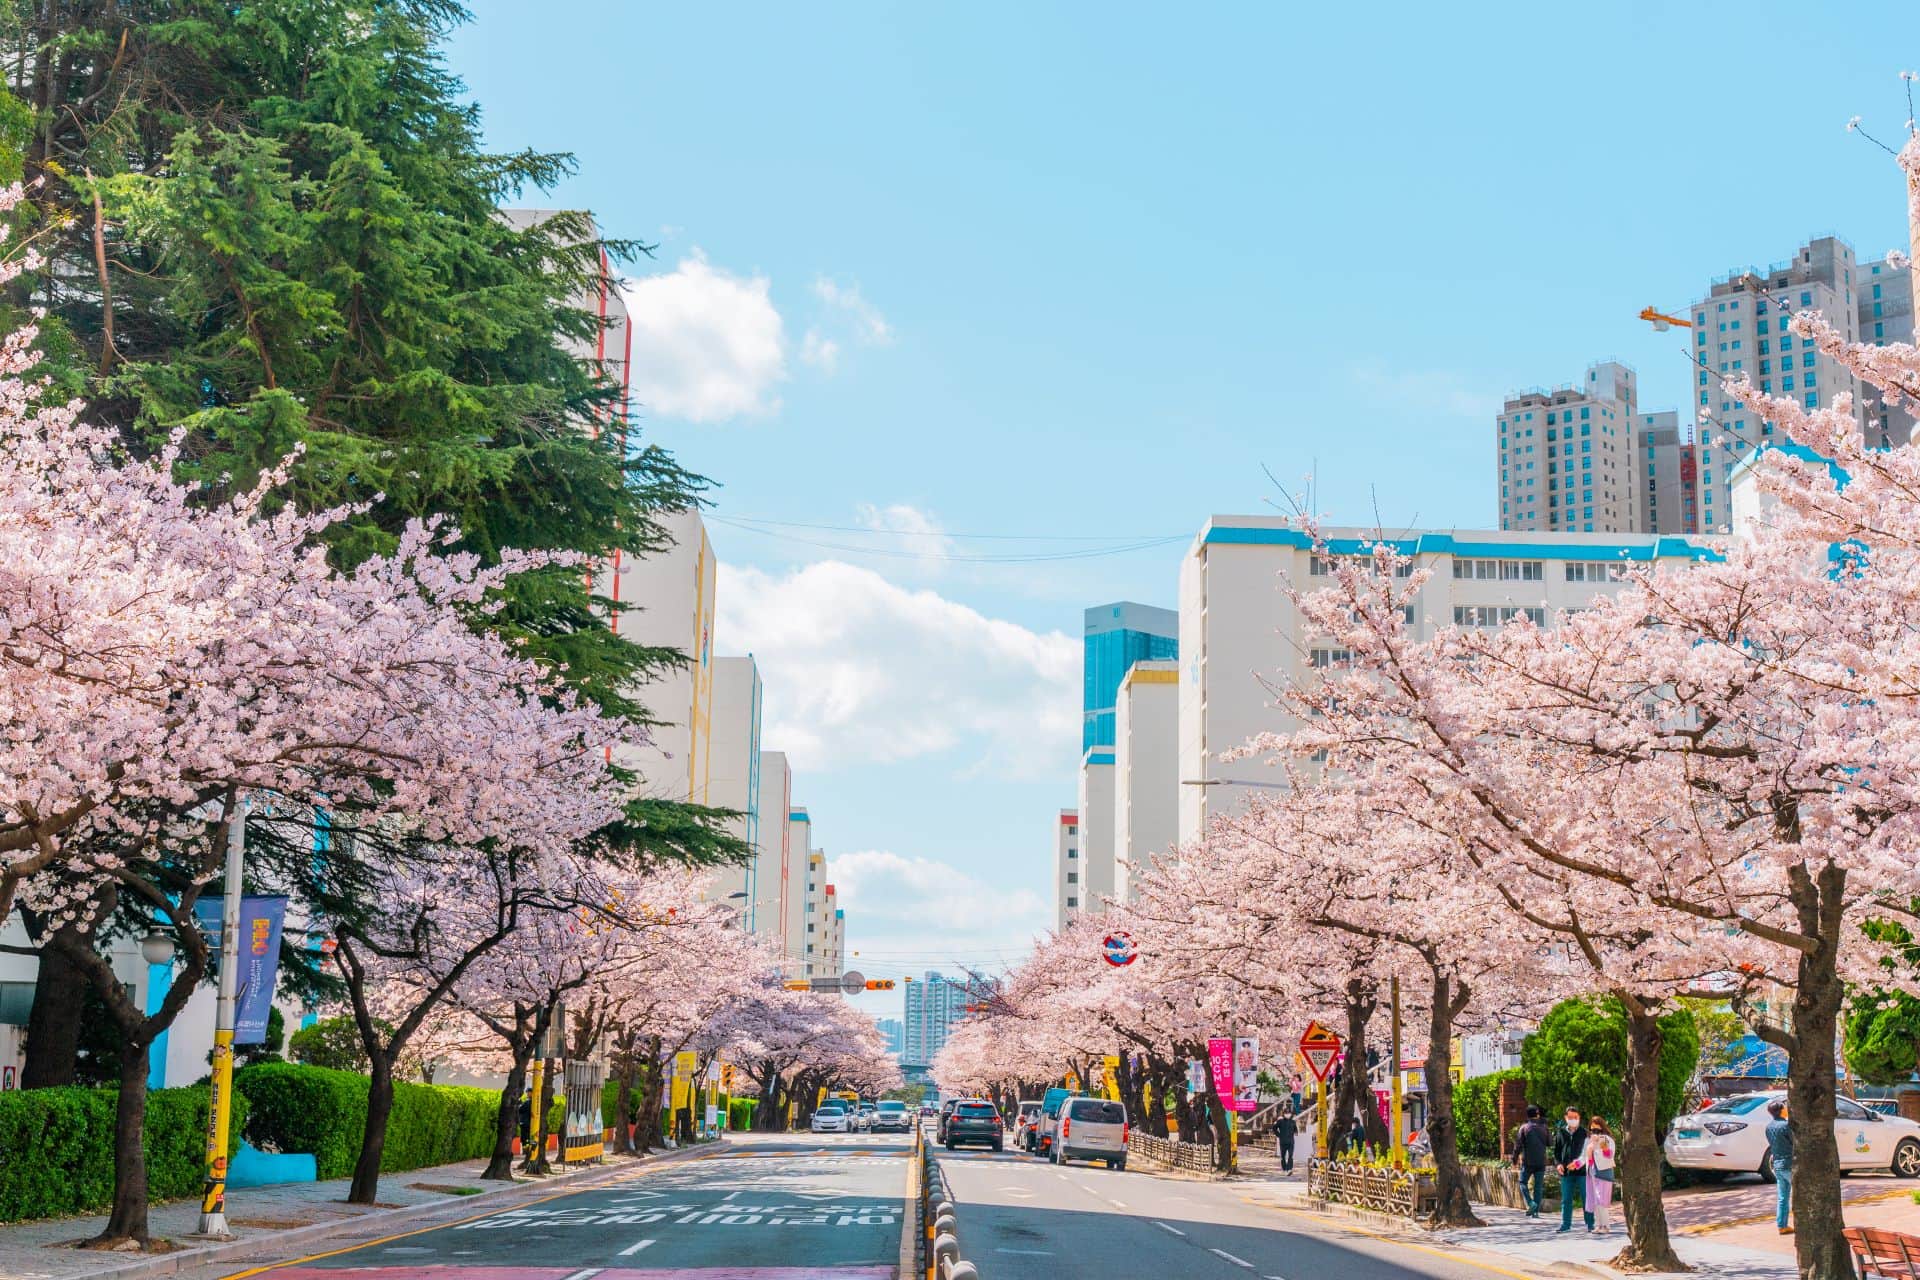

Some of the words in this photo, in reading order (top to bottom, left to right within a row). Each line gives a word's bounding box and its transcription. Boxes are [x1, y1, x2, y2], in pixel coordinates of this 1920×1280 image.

[1311, 1051, 1329, 1060] 천천히
[453, 1213, 668, 1230] 어린이
[696, 1212, 897, 1227] 어린이
